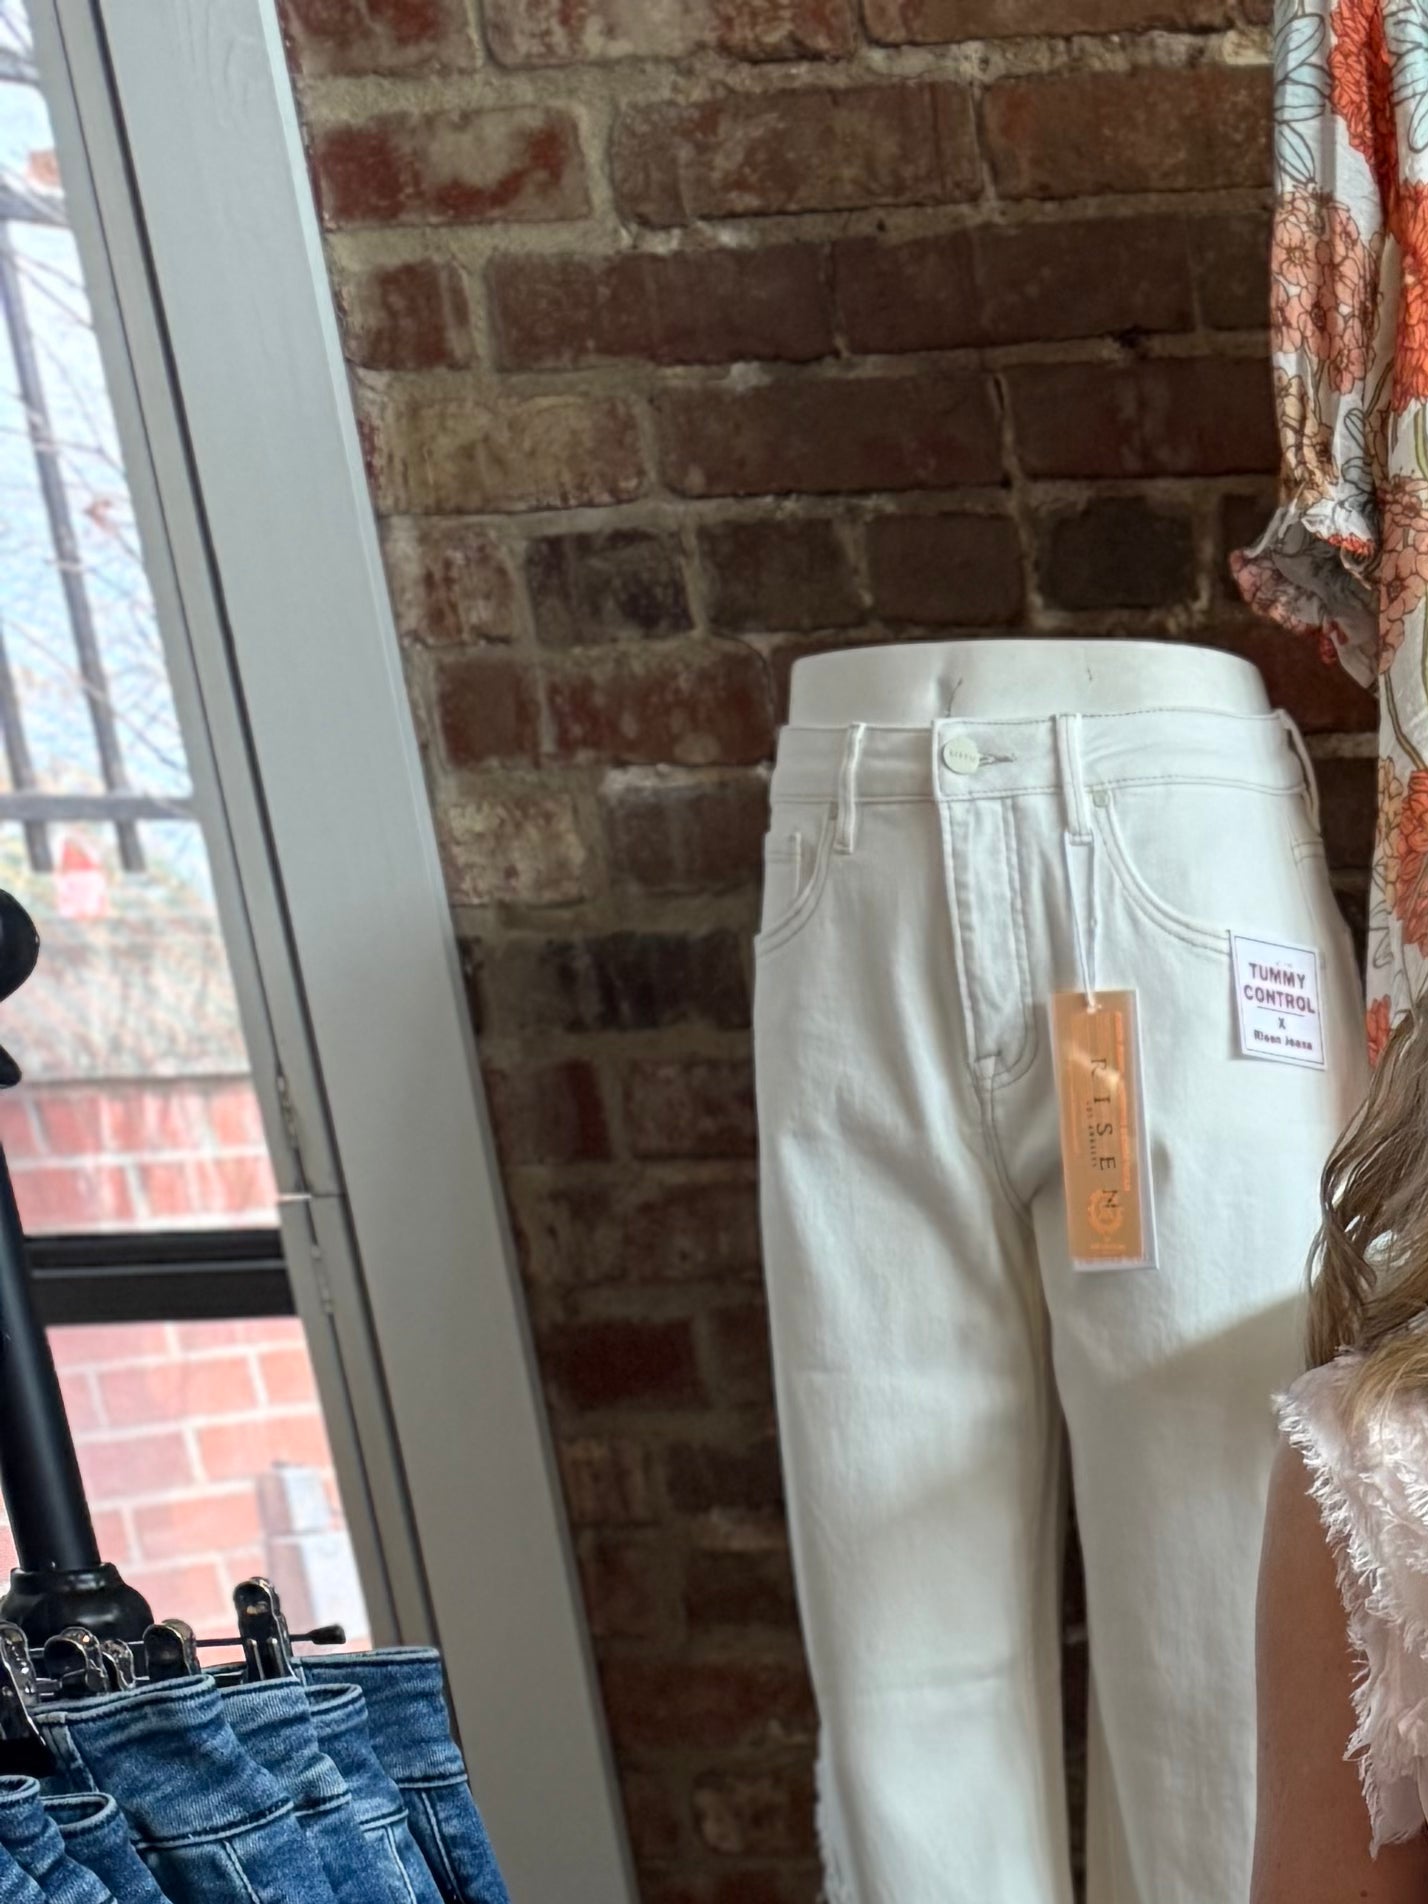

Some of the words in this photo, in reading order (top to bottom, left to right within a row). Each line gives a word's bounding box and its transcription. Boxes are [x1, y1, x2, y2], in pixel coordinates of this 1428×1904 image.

[1248, 962, 1306, 989] TUMMY
[1244, 985, 1316, 1014] CONTROL
[1091, 1058, 1122, 1209] RISEN
